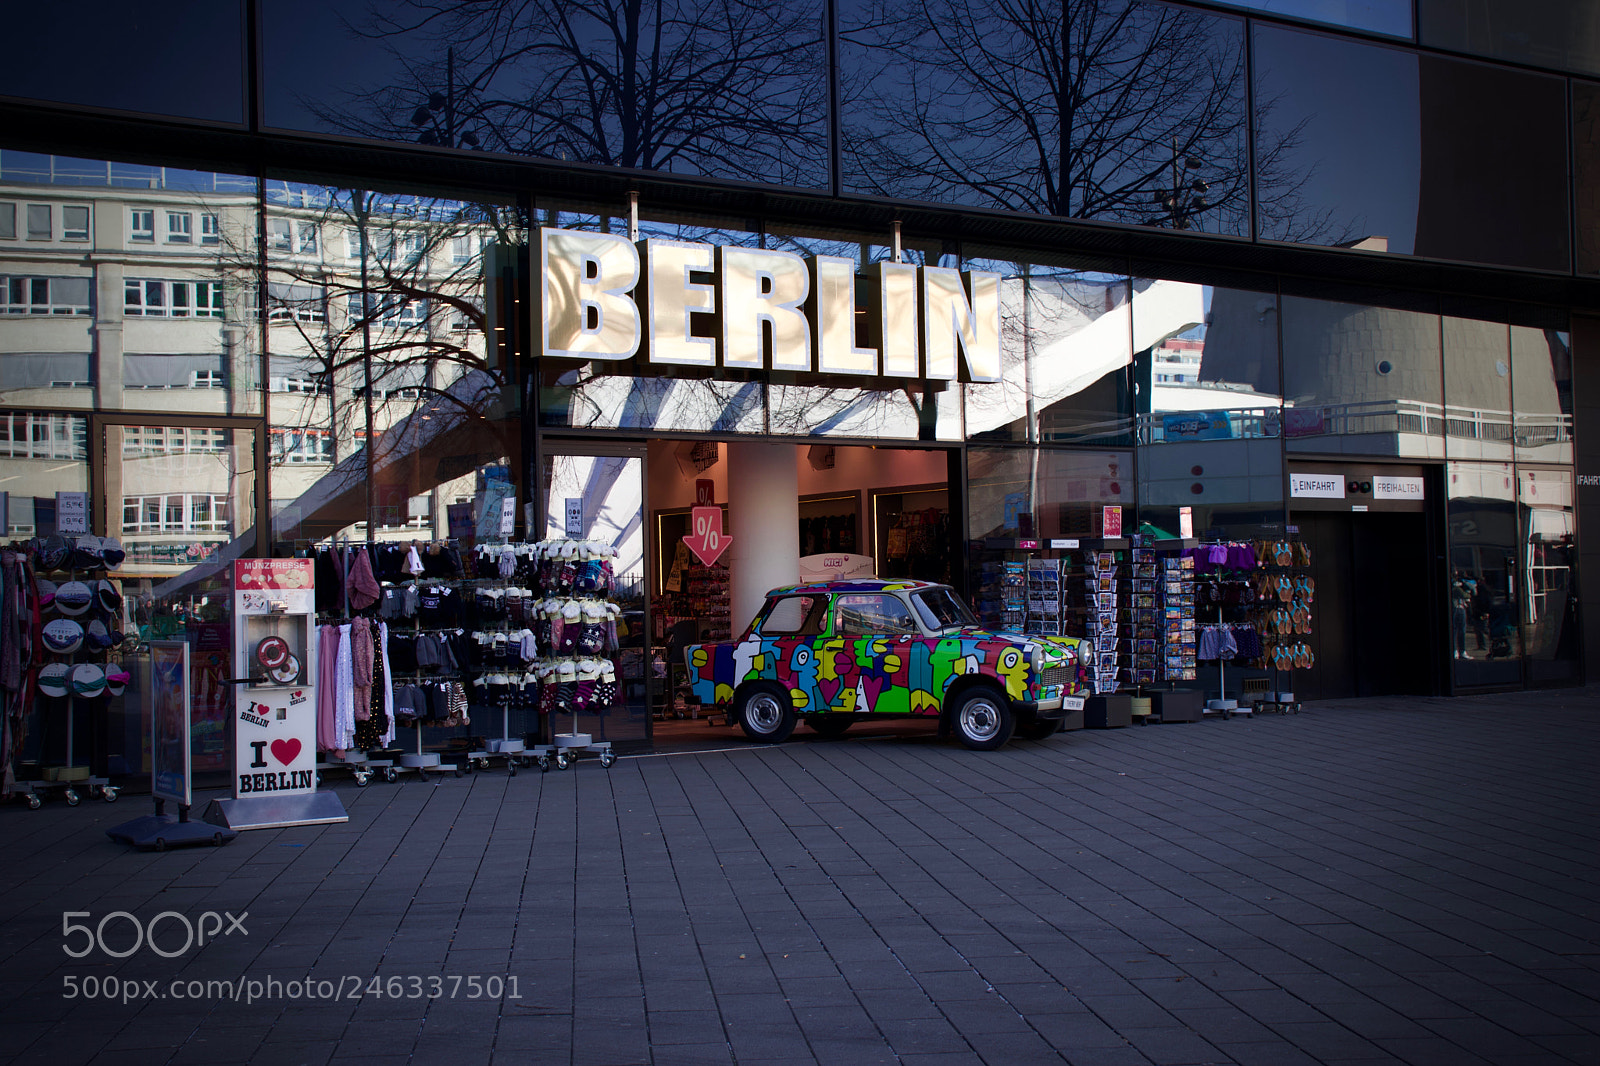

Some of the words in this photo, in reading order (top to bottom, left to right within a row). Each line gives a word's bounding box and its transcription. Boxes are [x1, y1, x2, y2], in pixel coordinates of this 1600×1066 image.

[531, 226, 1003, 383] BERLIN
[1299, 480, 1336, 491] EINFAHRT
[1377, 482, 1420, 494] FREIHALTEN
[244, 561, 305, 570] MÜNZPRESSE
[247, 701, 258, 713] I
[289, 696, 307, 706] BERLIN
[240, 711, 270, 728] BERLIN
[250, 741, 267, 768] I
[240, 770, 313, 793] BERLIN
